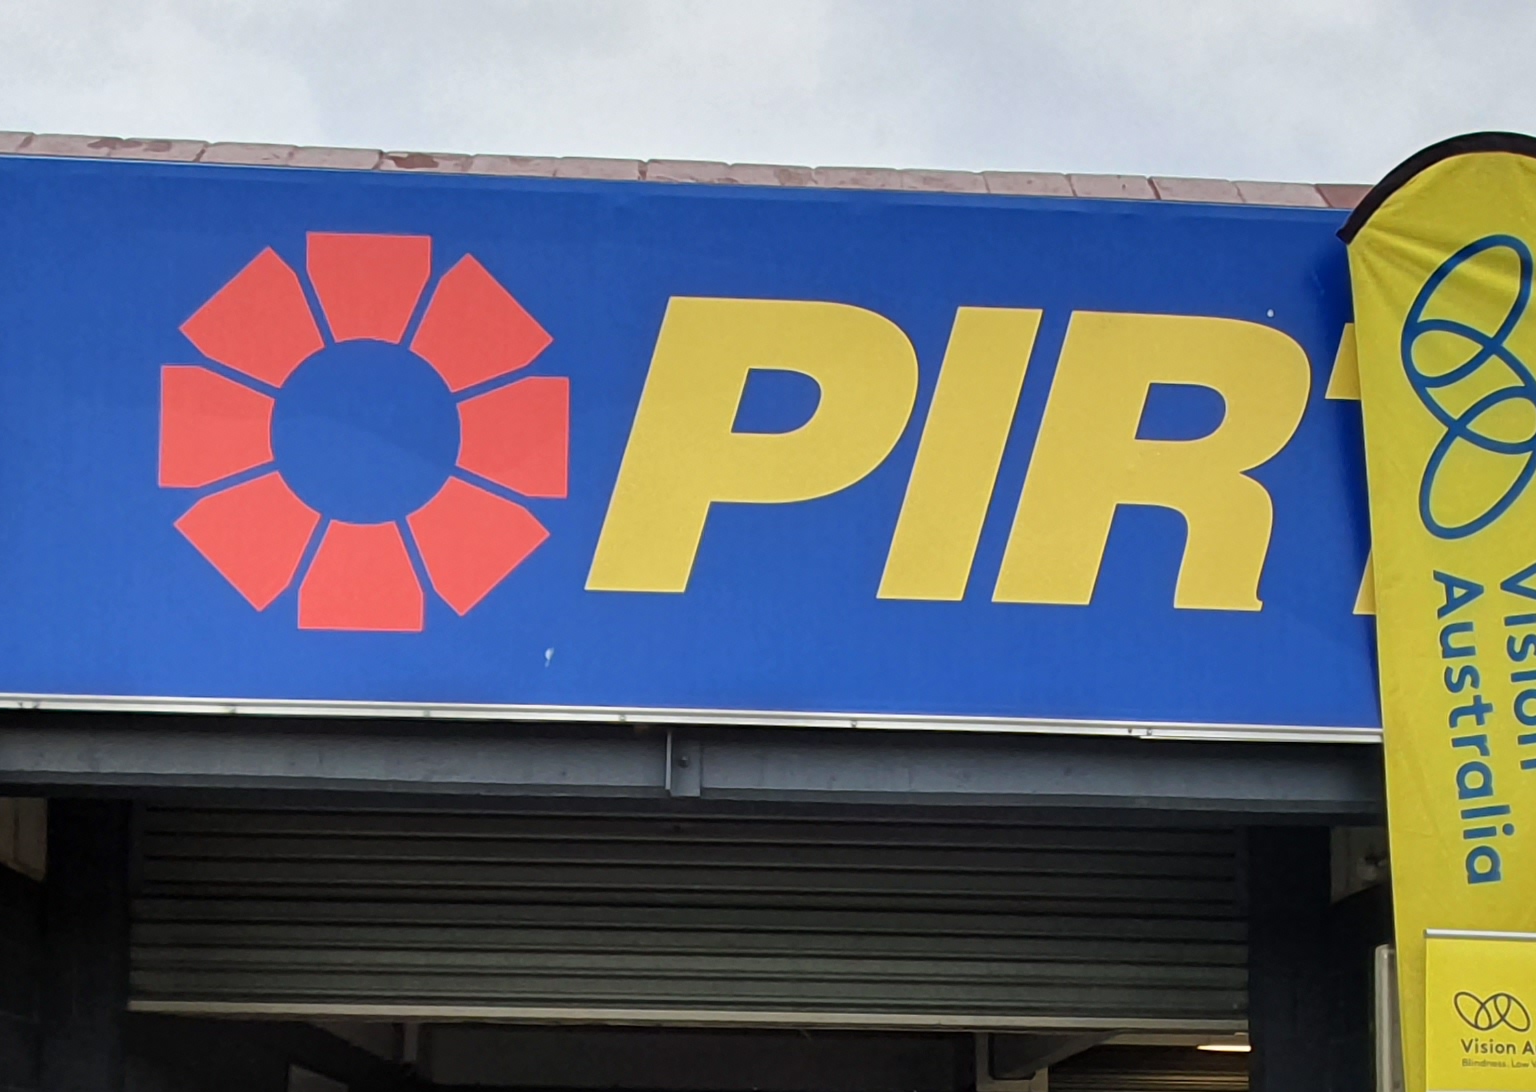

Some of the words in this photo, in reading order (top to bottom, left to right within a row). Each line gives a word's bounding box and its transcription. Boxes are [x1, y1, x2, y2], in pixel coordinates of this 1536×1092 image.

[1433, 570, 1519, 887] Australia
[1460, 1038, 1517, 1055] Vision
[1511, 1059, 1529, 1069] Low
